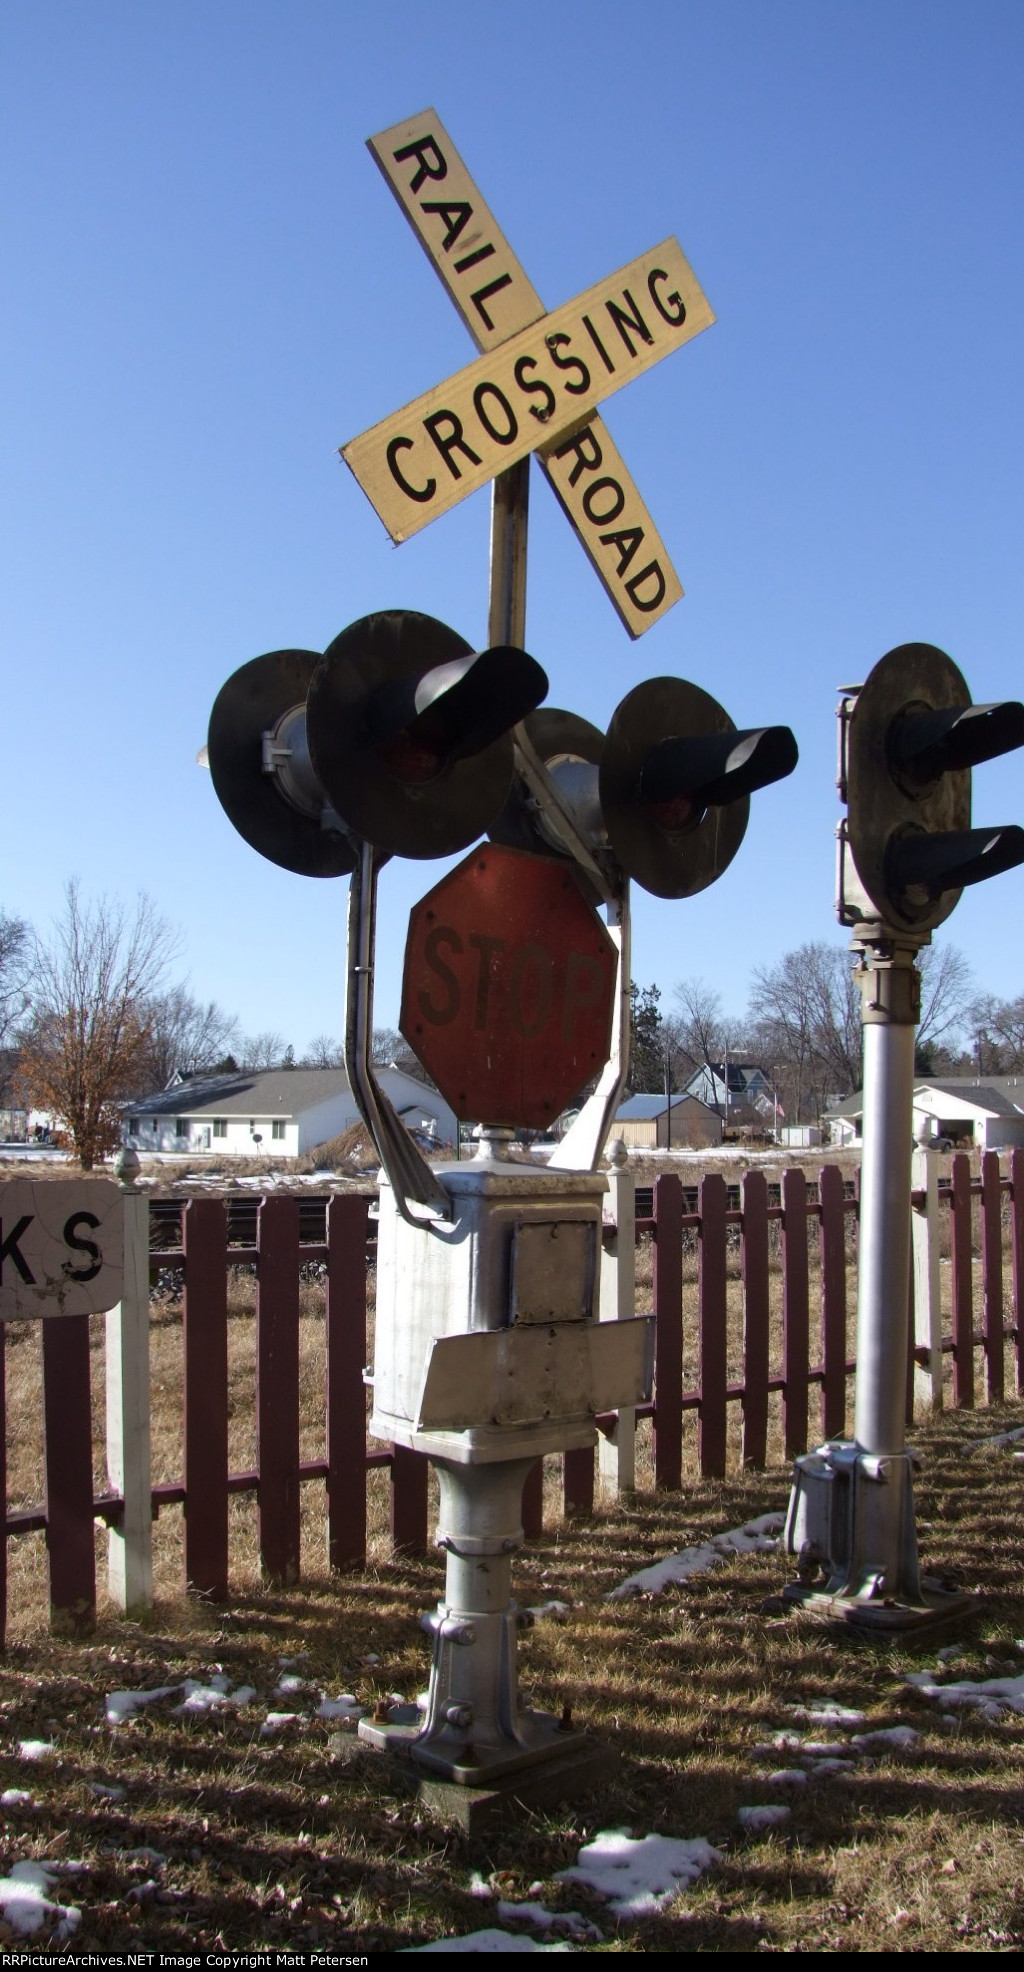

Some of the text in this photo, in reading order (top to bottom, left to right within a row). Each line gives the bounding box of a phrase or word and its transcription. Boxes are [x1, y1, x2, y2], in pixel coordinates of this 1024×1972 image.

[392, 133, 513, 331] RAIL
[385, 267, 687, 503] CROSSING
[554, 425, 666, 613] ROAD
[417, 925, 604, 1044] STOP
